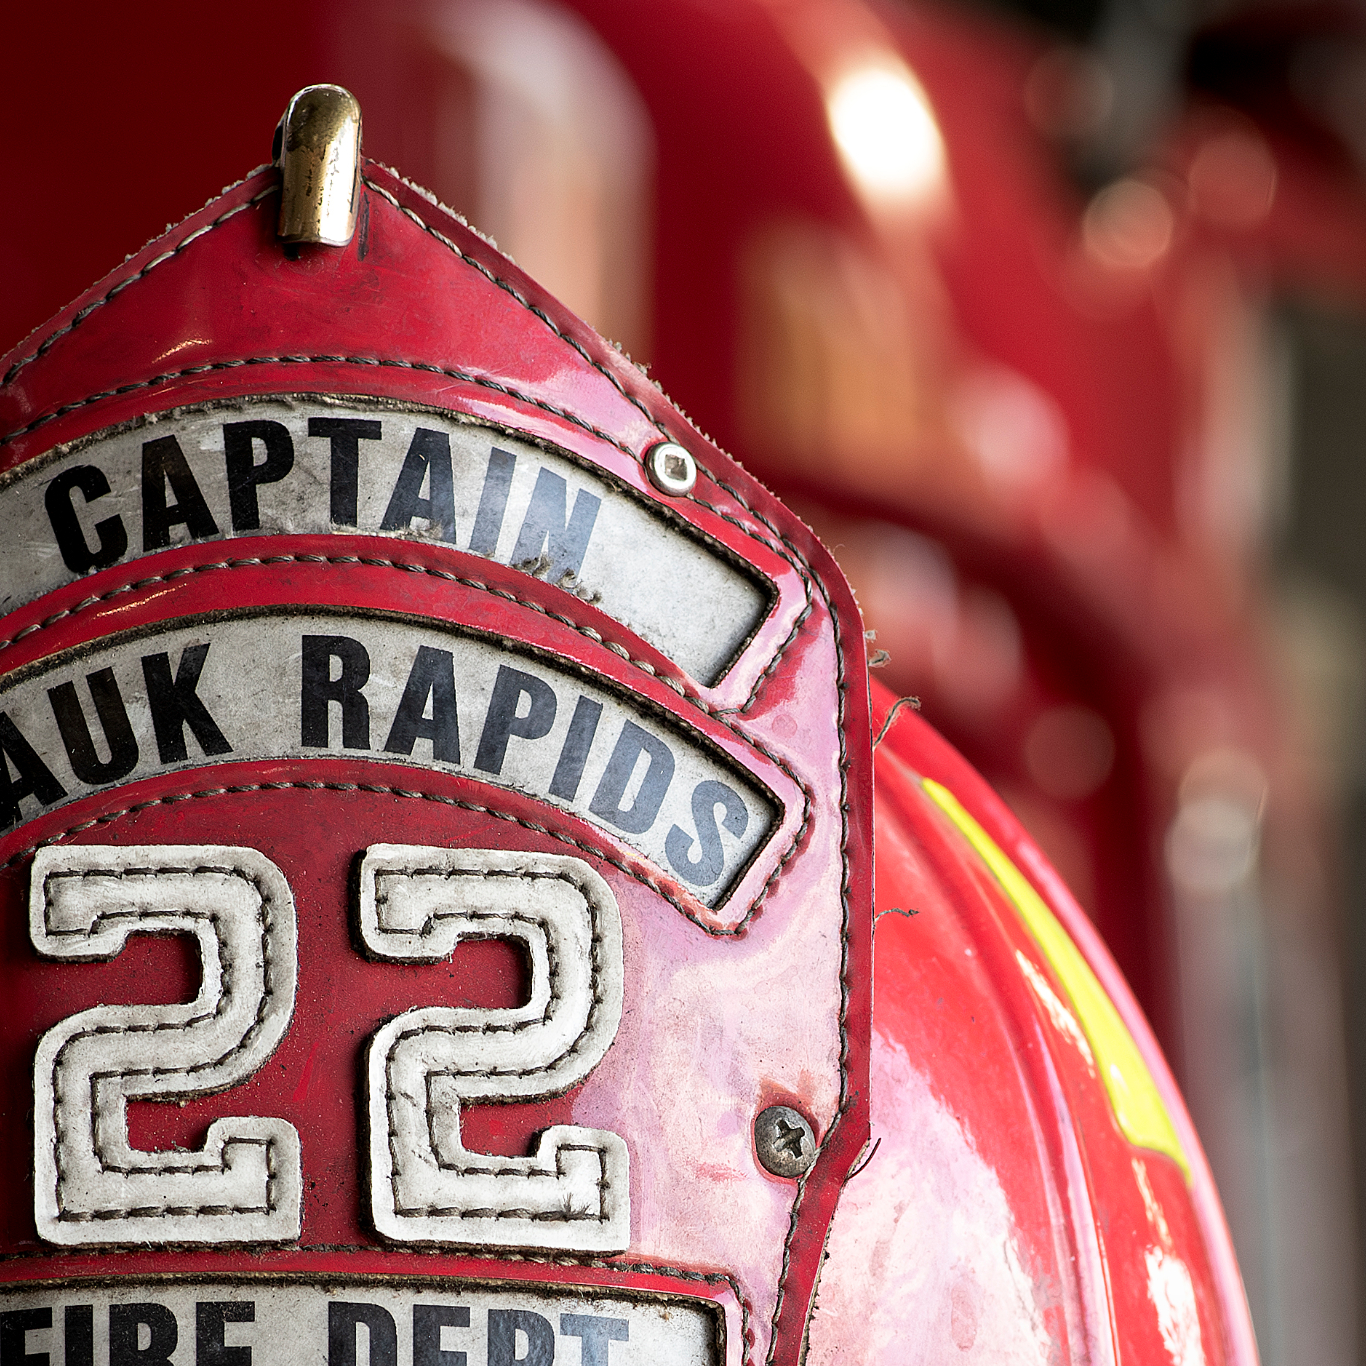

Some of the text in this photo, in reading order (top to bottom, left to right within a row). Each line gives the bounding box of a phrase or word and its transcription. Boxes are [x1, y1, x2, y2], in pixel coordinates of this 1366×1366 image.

[44, 416, 602, 585] CAPTAIN
[299, 633, 751, 887] RAPIDS
[31, 843, 630, 1255] 22
